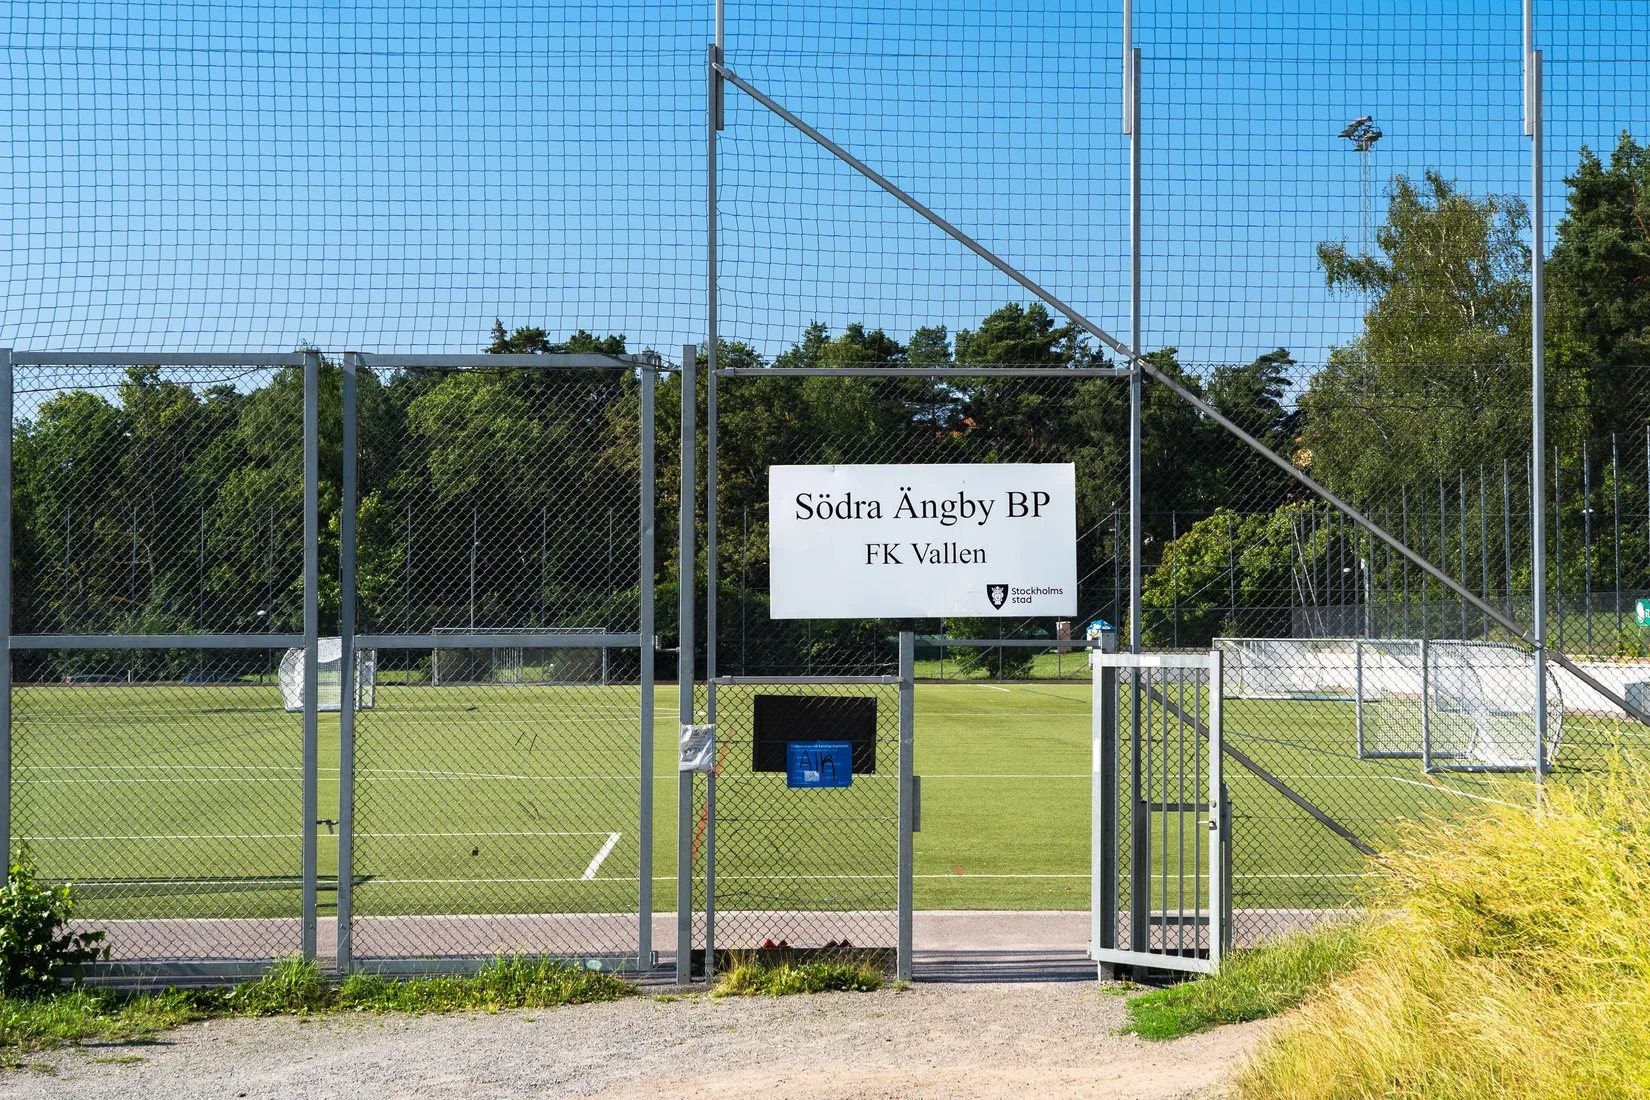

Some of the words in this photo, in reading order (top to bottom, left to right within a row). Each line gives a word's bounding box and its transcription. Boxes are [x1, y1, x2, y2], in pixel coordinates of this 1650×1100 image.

[795, 491, 884, 520] Södra
[892, 486, 996, 527] Ängby
[1005, 491, 1051, 518] BP
[865, 543, 904, 565] FK
[911, 541, 987, 565] Vallen
[1011, 586, 1064, 596] Stockholms
[1011, 595, 1032, 604] stad
